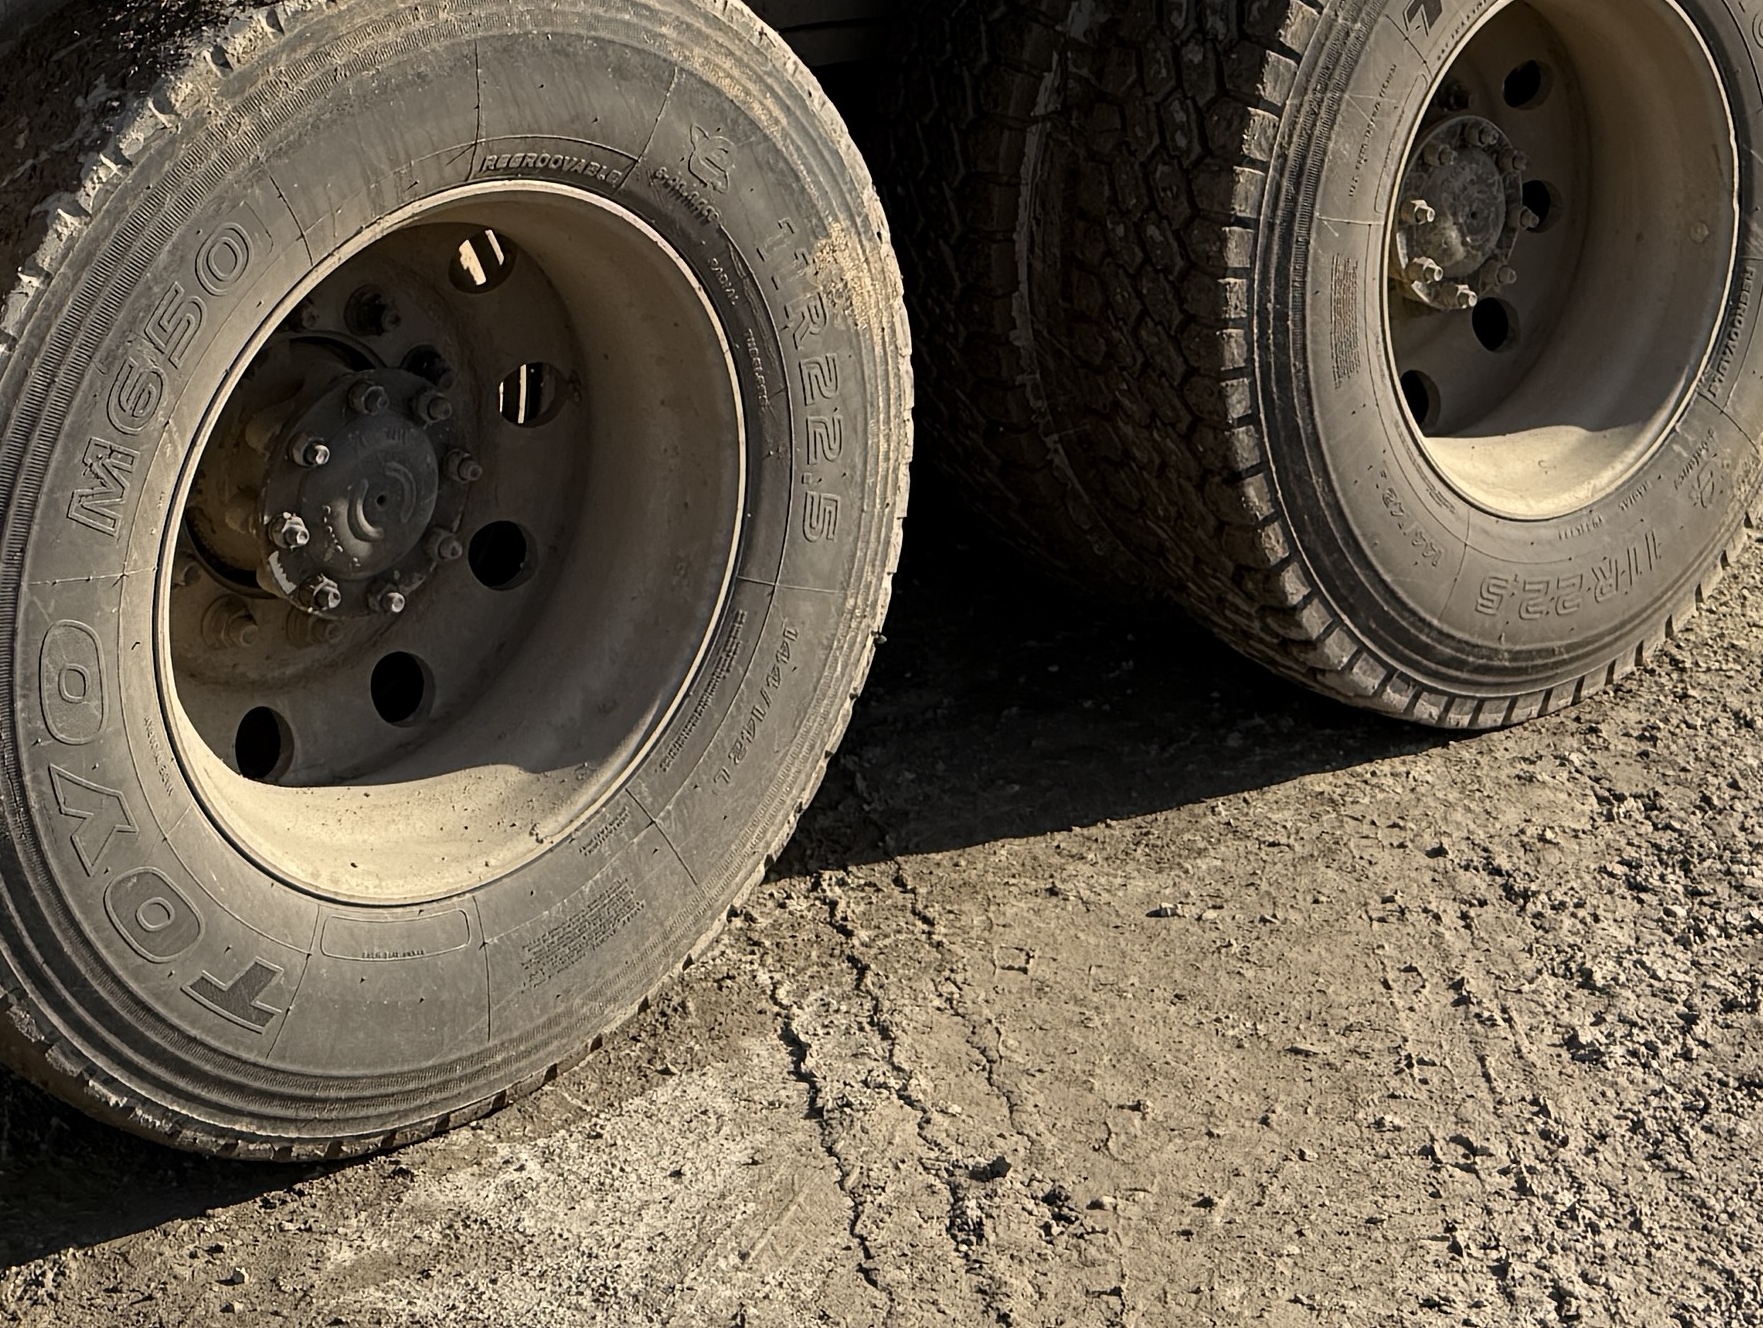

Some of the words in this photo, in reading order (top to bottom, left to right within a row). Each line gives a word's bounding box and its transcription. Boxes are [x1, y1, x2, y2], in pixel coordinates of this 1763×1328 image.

[481, 151, 623, 185] REGROOVABLE
[67, 221, 252, 537] M650
[39, 619, 284, 1035] TOYO
